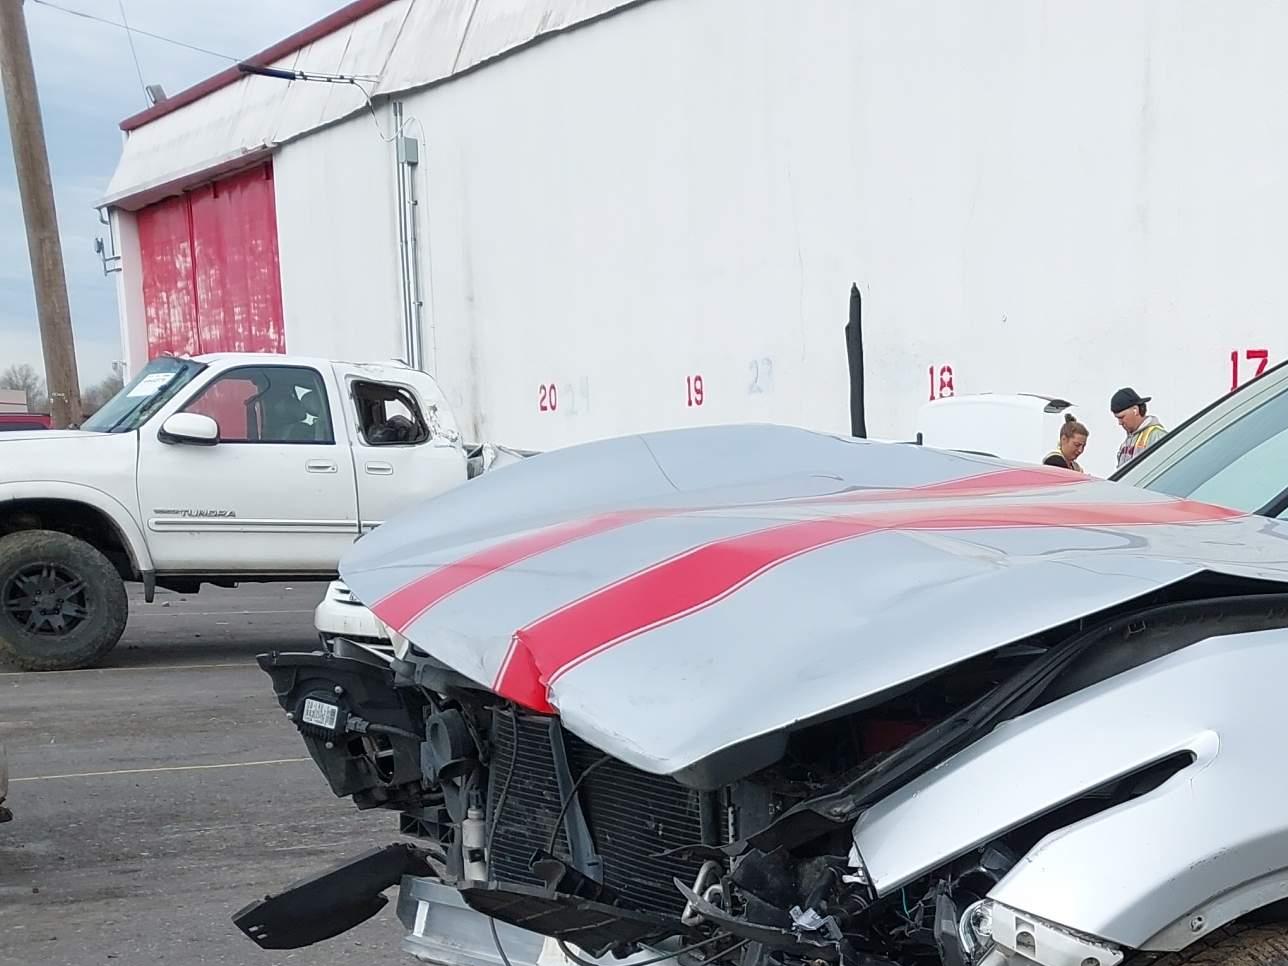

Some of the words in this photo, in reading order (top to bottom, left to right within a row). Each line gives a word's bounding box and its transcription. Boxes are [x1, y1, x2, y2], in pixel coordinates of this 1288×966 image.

[929, 365, 954, 401] 18
[1230, 349, 1268, 393] 17
[538, 383, 557, 412] 20
[686, 375, 704, 407] 19
[180, 508, 236, 519] TUNDRA
